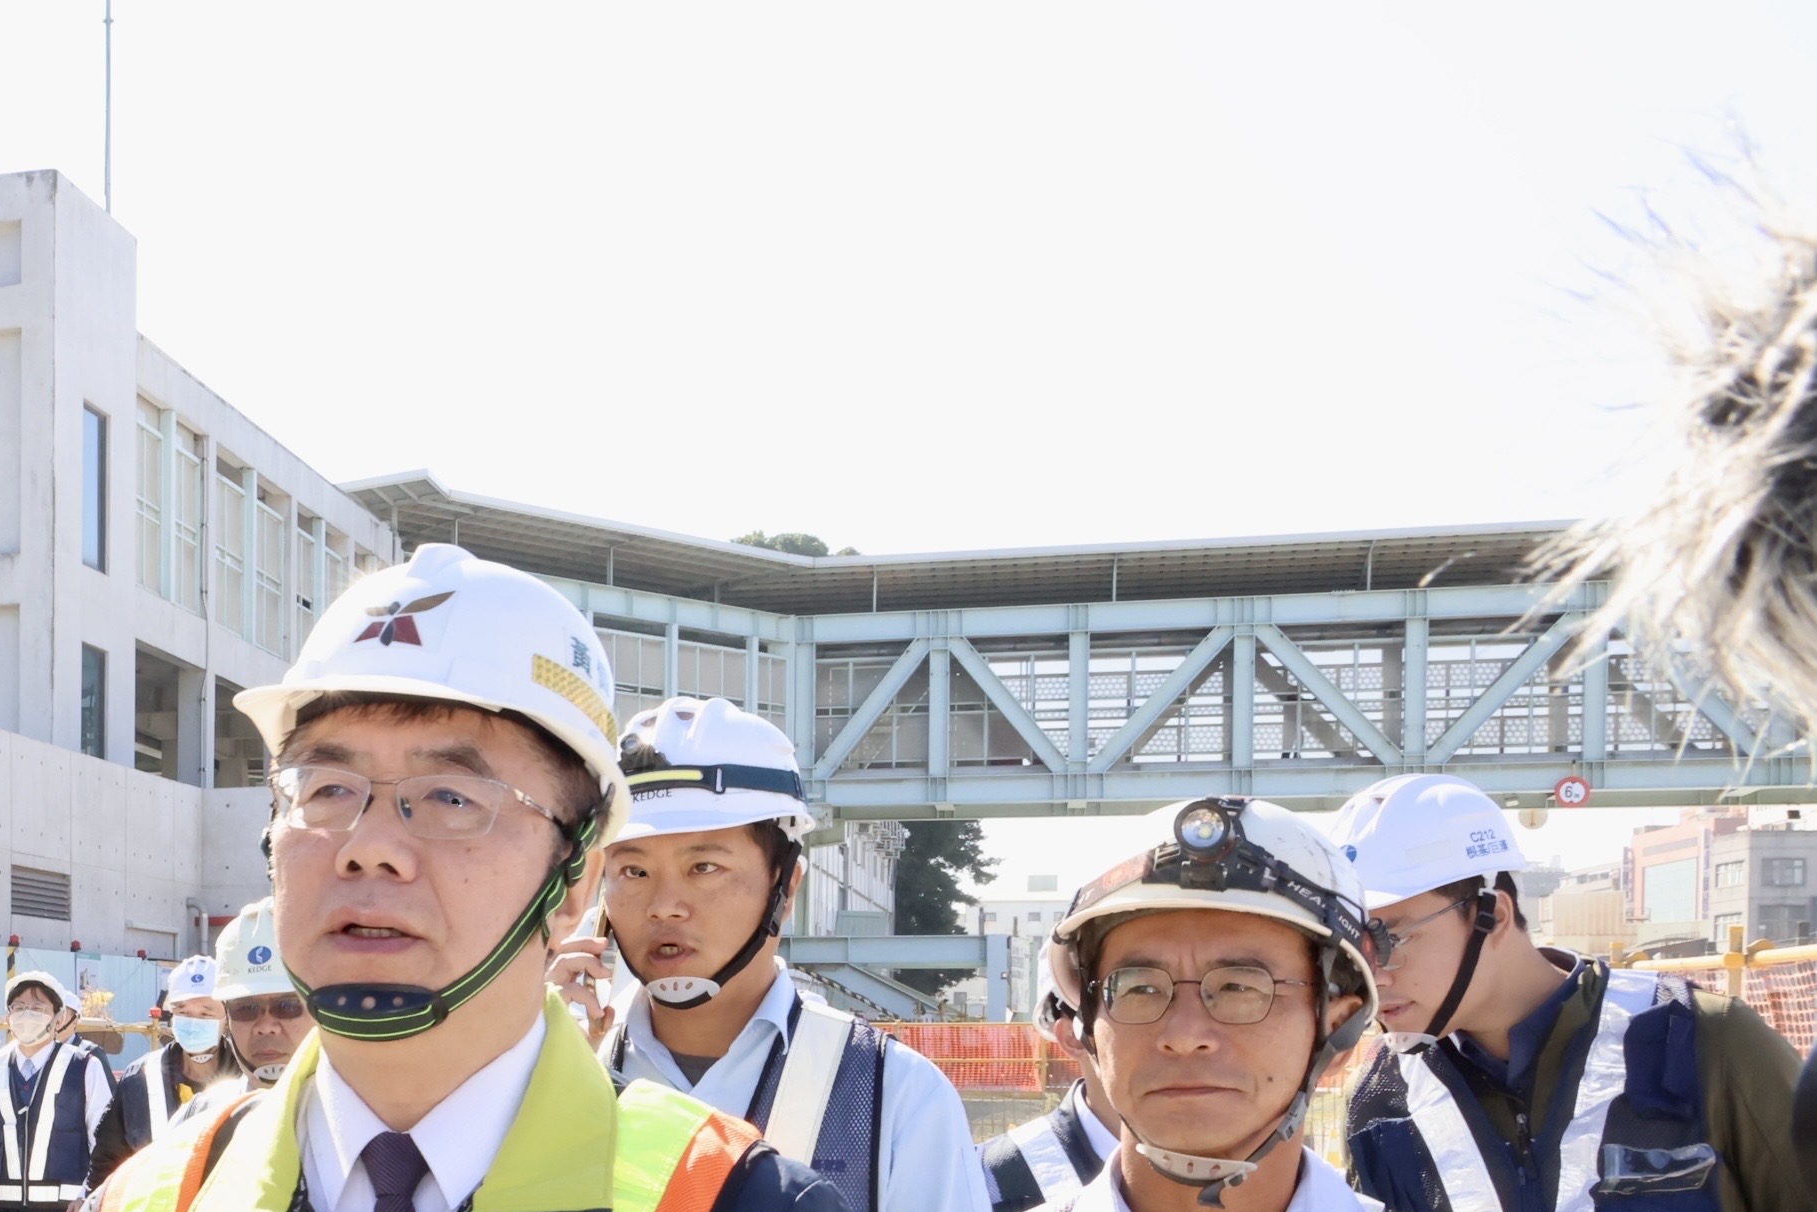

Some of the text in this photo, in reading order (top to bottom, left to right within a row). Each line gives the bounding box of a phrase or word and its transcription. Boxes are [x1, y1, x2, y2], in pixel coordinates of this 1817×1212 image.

[632, 788, 673, 804] KEDGE
[1470, 829, 1496, 842] C212
[1287, 880, 1361, 939] HEAIGHT
[248, 964, 273, 974] KEDGE
